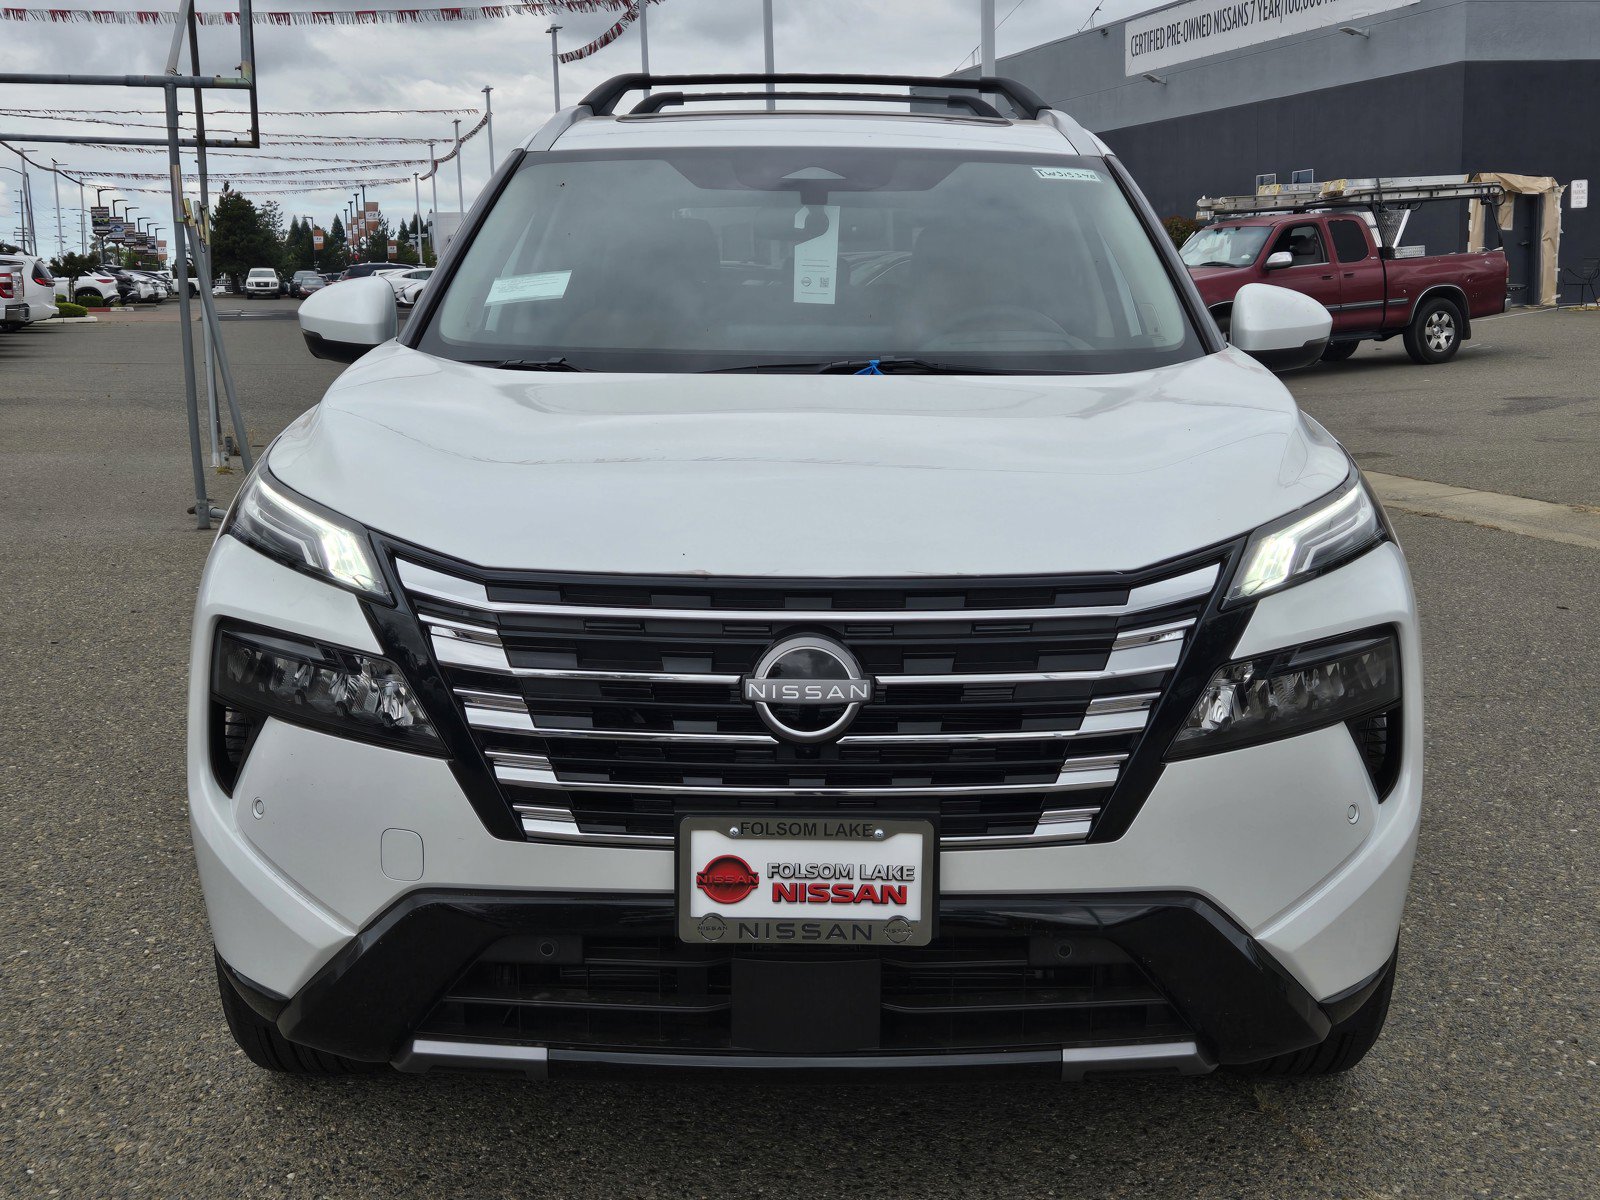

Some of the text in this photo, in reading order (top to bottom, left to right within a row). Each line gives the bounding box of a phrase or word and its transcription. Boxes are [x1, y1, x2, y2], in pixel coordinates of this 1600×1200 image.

[1130, 26, 1165, 57] CERTIFIED
[1166, 13, 1212, 47] PRE-OWNED
[1213, 2, 1249, 34] NISSANS
[1257, 0, 1321, 23] YEAR/100,
[748, 683, 868, 699] NISSAN
[740, 821, 873, 837] FOLSOM LAKE
[696, 875, 760, 885] NISSAN
[766, 863, 915, 881] FOLSOM LAKE
[772, 882, 907, 904] NISSAN
[738, 922, 872, 940] NISSAN
